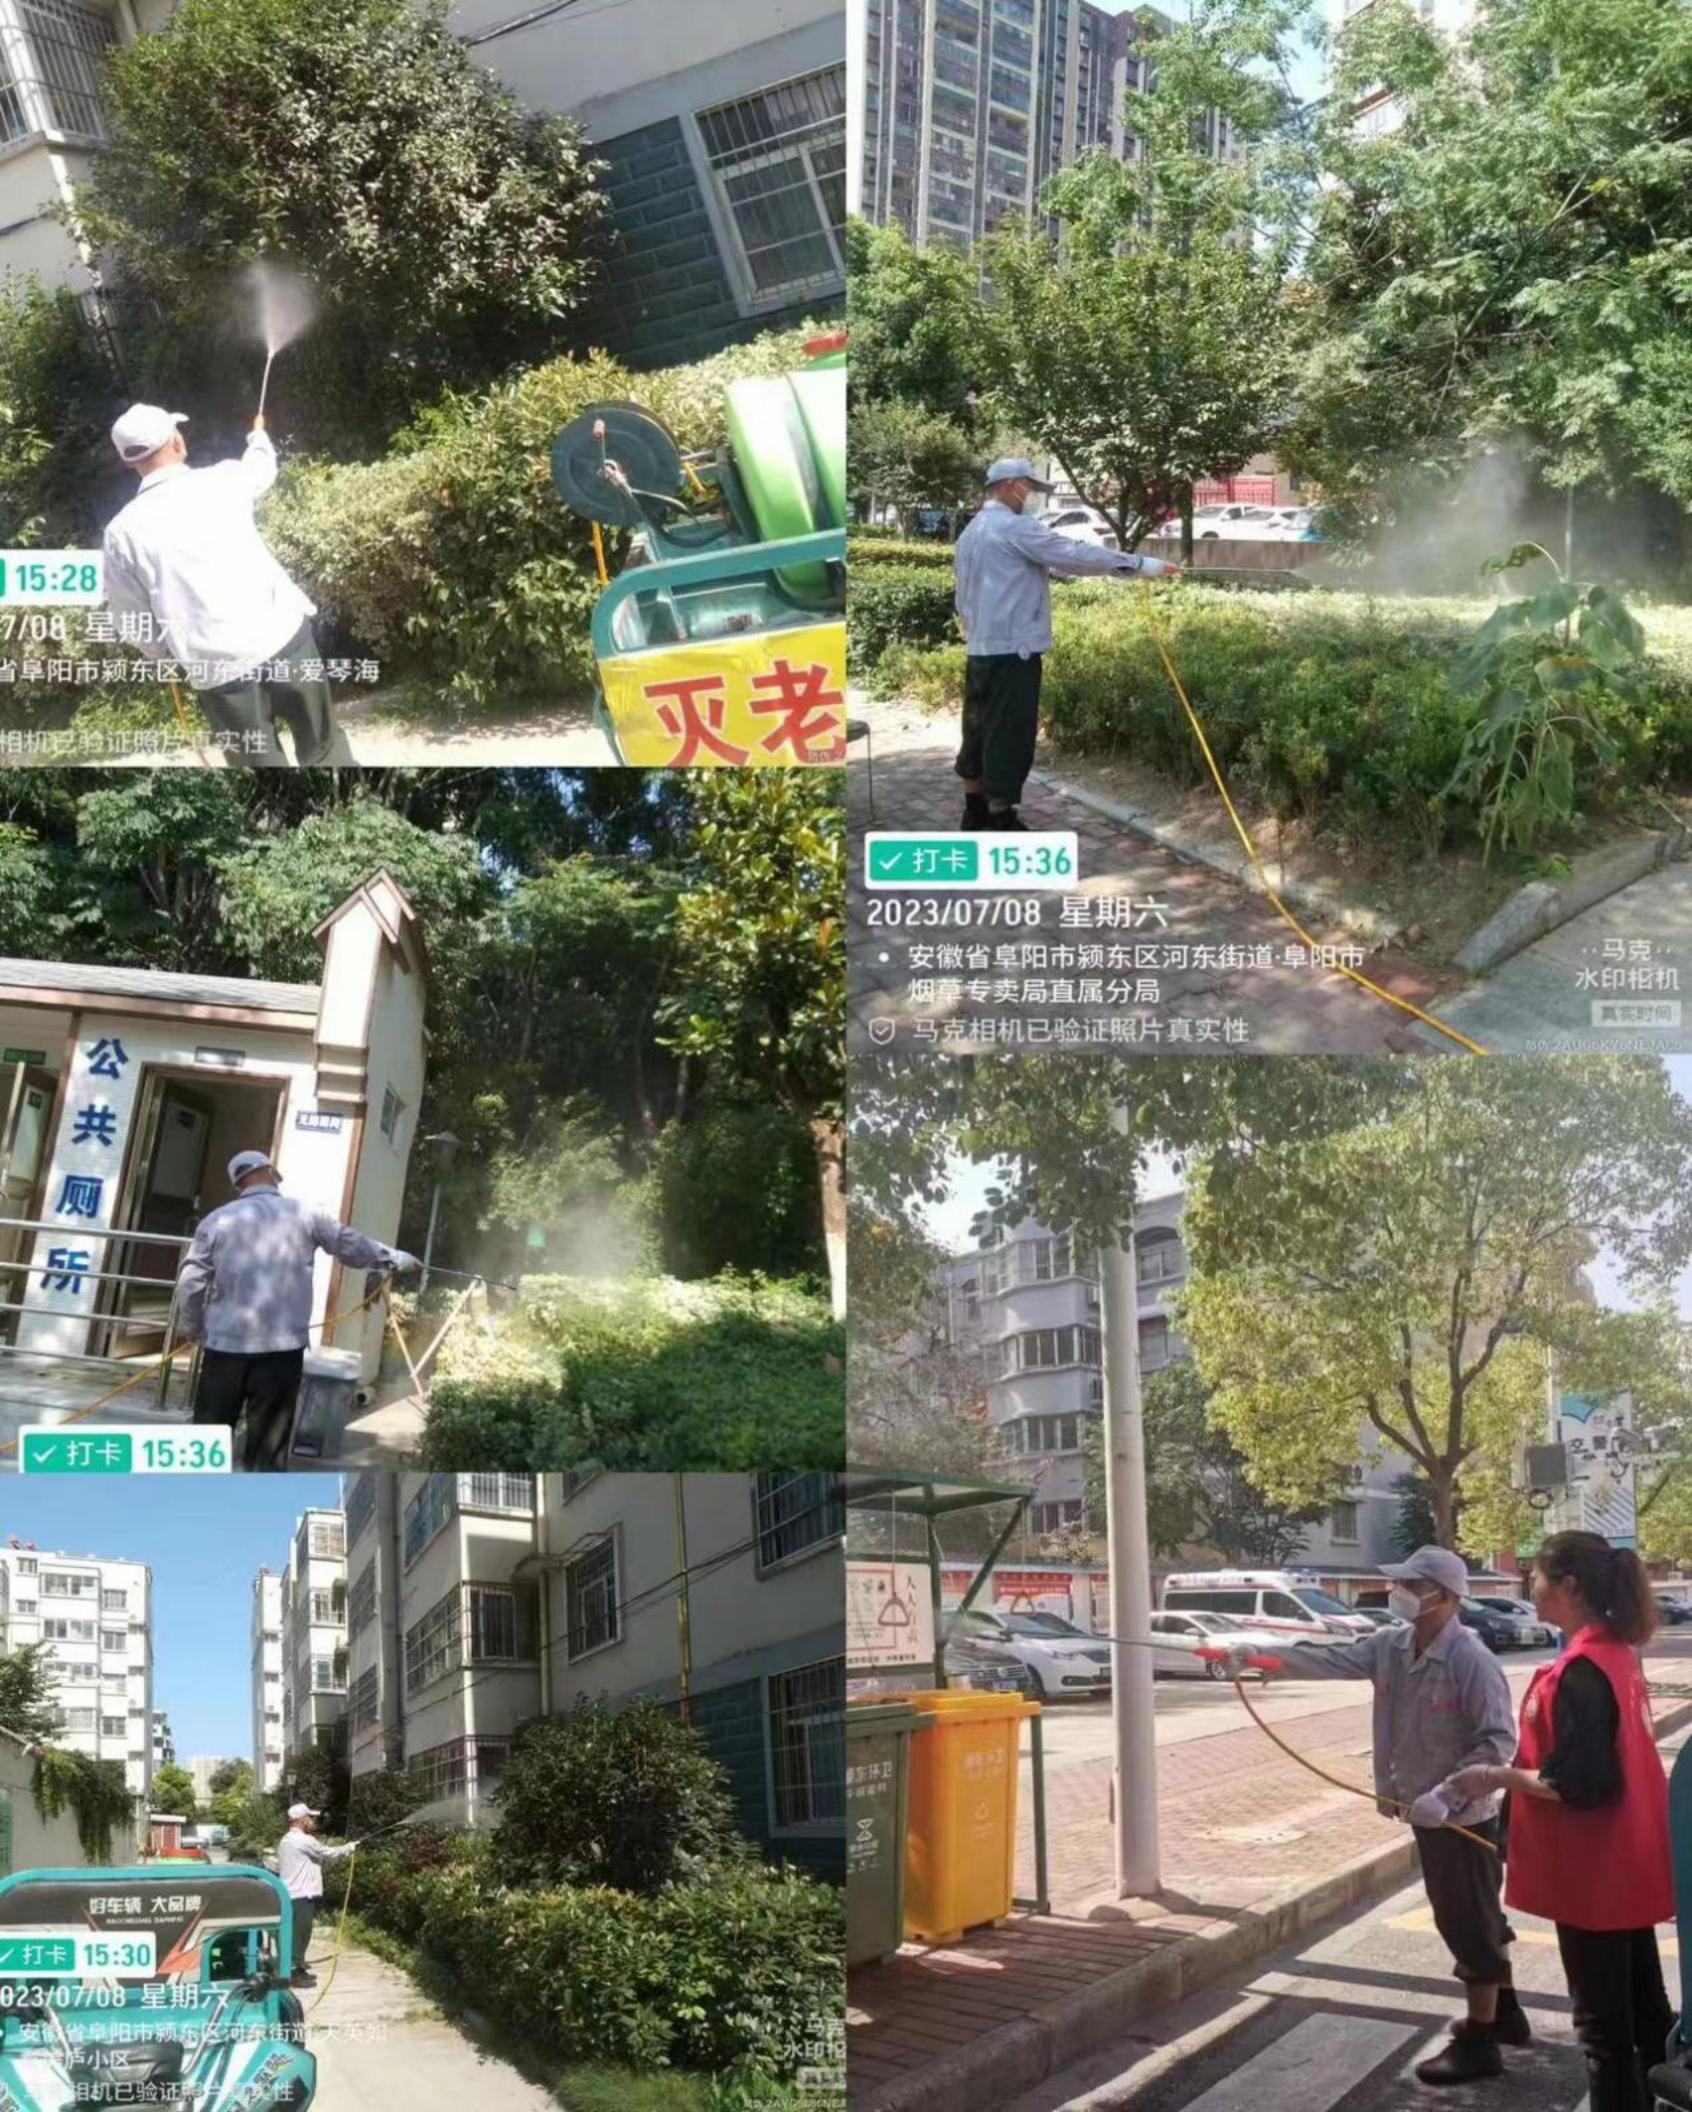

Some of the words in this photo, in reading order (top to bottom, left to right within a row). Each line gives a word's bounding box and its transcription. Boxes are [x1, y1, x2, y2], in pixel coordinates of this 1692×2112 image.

[644, 660, 847, 766] 灭老
[40, 1037, 129, 1295] 公共厕所
